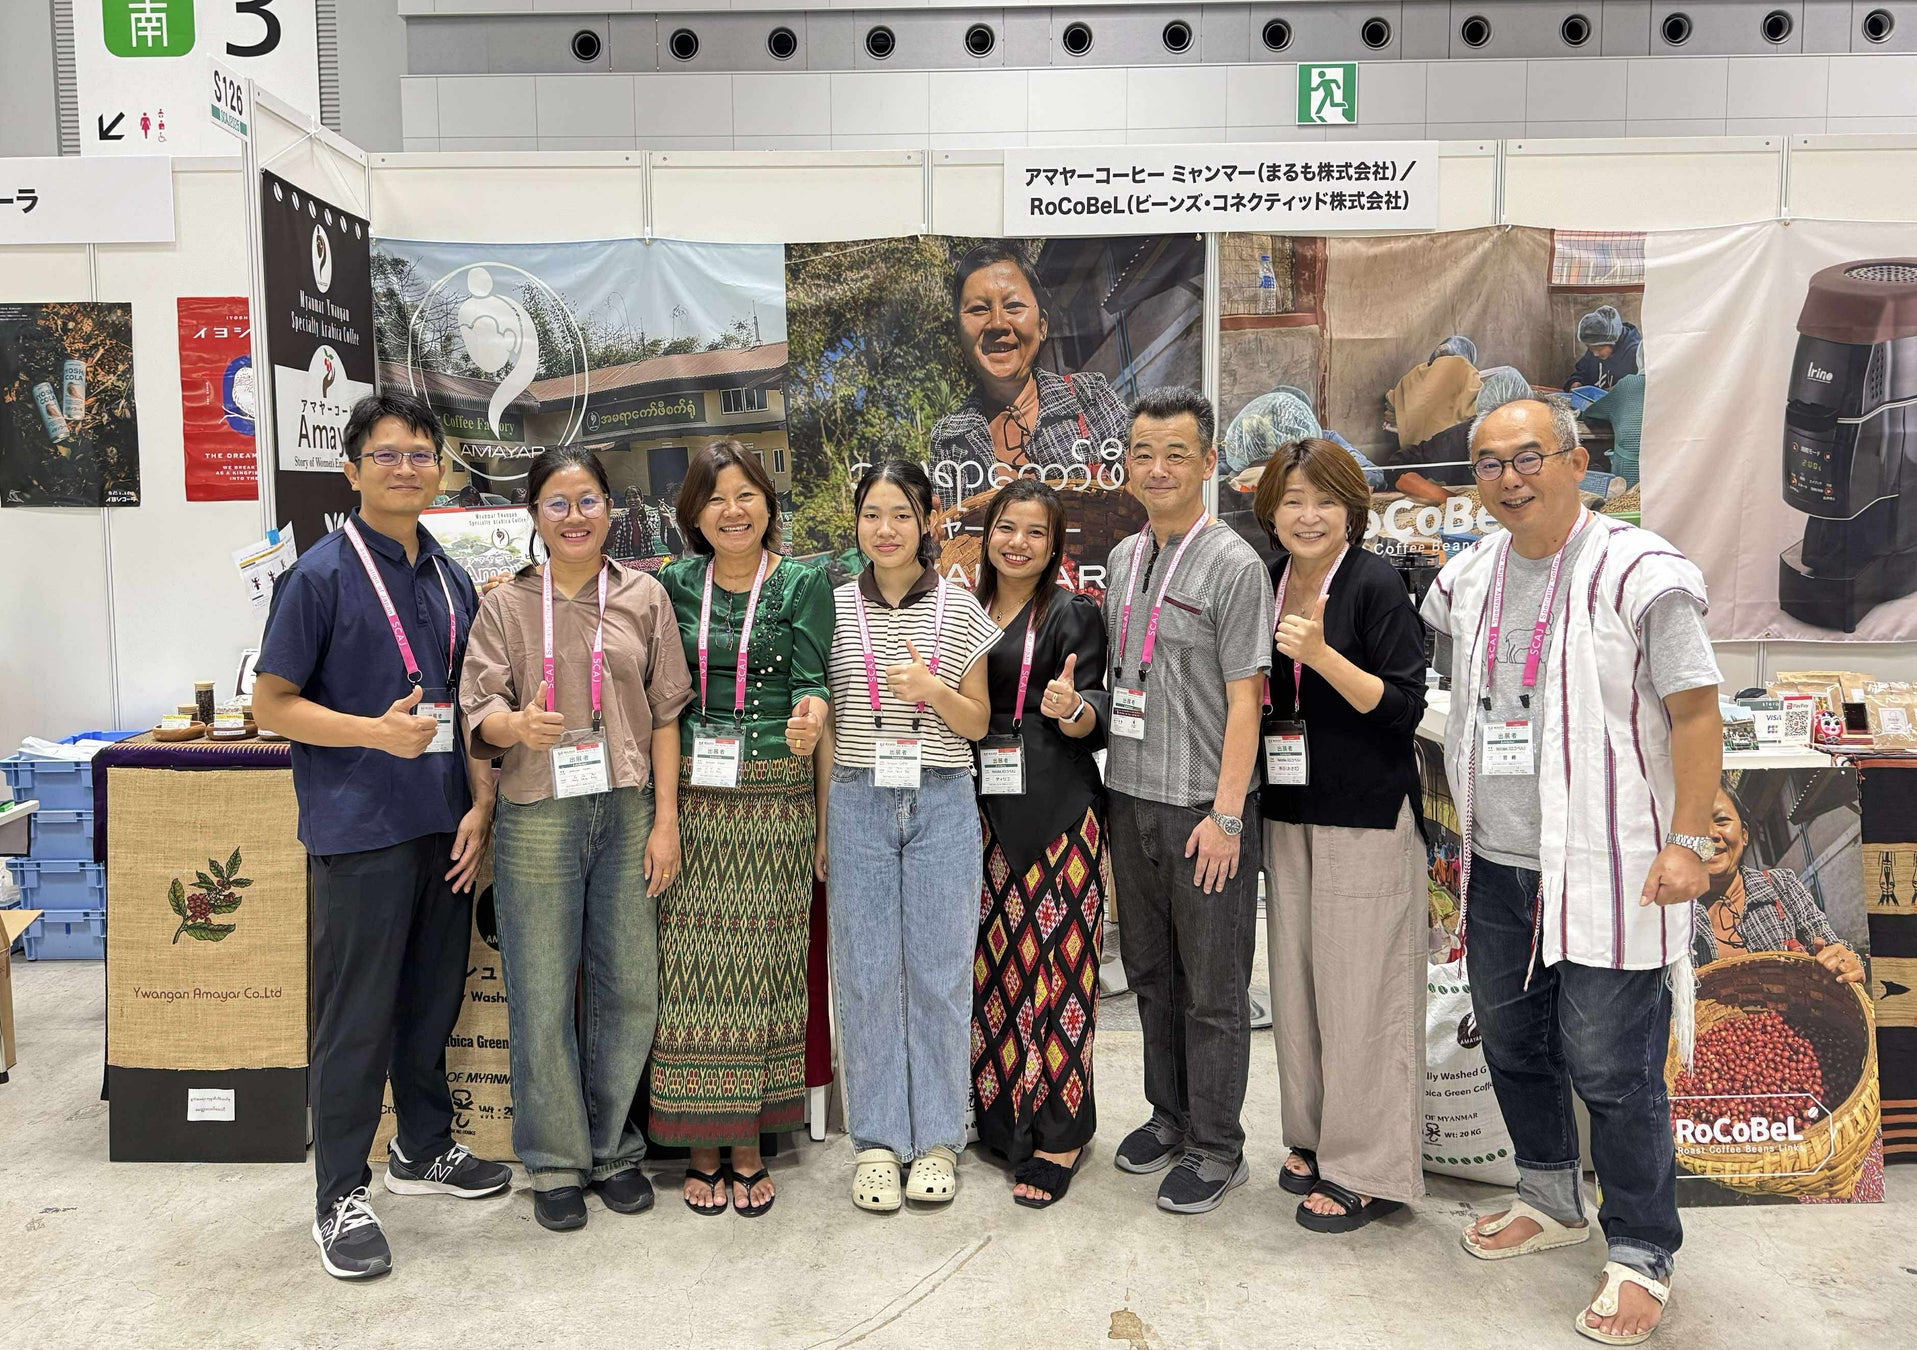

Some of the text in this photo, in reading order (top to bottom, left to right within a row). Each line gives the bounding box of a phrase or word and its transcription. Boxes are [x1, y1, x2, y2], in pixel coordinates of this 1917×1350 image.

[128, 0, 168, 47] 南
[226, 0, 282, 57] 3
[213, 69, 243, 116] S126
[1025, 165, 1165, 187] アマヤーコーヒー
[299, 289, 324, 315] Myanmar
[443, 412, 515, 436] Coffee Faory
[1373, 542, 1426, 556] Coffee
[376, 584, 386, 594] of
[381, 594, 395, 616] Japan
[1492, 563, 1505, 626] Specialty Coffee
[1540, 556, 1560, 620] Specialty Coffee
[391, 620, 408, 647] SCAJ
[1121, 611, 1131, 634] SCAJ
[1147, 611, 1161, 636] SCAJ
[1488, 632, 1498, 660] SCAJ
[1530, 627, 1545, 656] SCAJ
[590, 657, 602, 683] SCAJ
[699, 655, 707, 679] SCAJ
[736, 658, 747, 683] SCAJ
[866, 657, 877, 682] SCAJ
[928, 662, 937, 675] SC
[1019, 669, 1029, 693] SCAJ
[133, 986, 190, 1004] Ywangan
[193, 987, 241, 1003] Amayar
[477, 1034, 509, 1049] Green
[446, 1071, 463, 1083] OF
[1440, 1067, 1479, 1081] Washed
[1444, 1088, 1472, 1098] Green
[1437, 1112, 1479, 1122] MYANMAR
[1460, 1130, 1469, 1138] 20
[1470, 1128, 1482, 1137] KG
[1675, 1115, 1805, 1145] RoCoBeL
[1709, 1145, 1741, 1154] Coffee
[1745, 1144, 1775, 1153] Beans
[1779, 1143, 1807, 1152] Links
